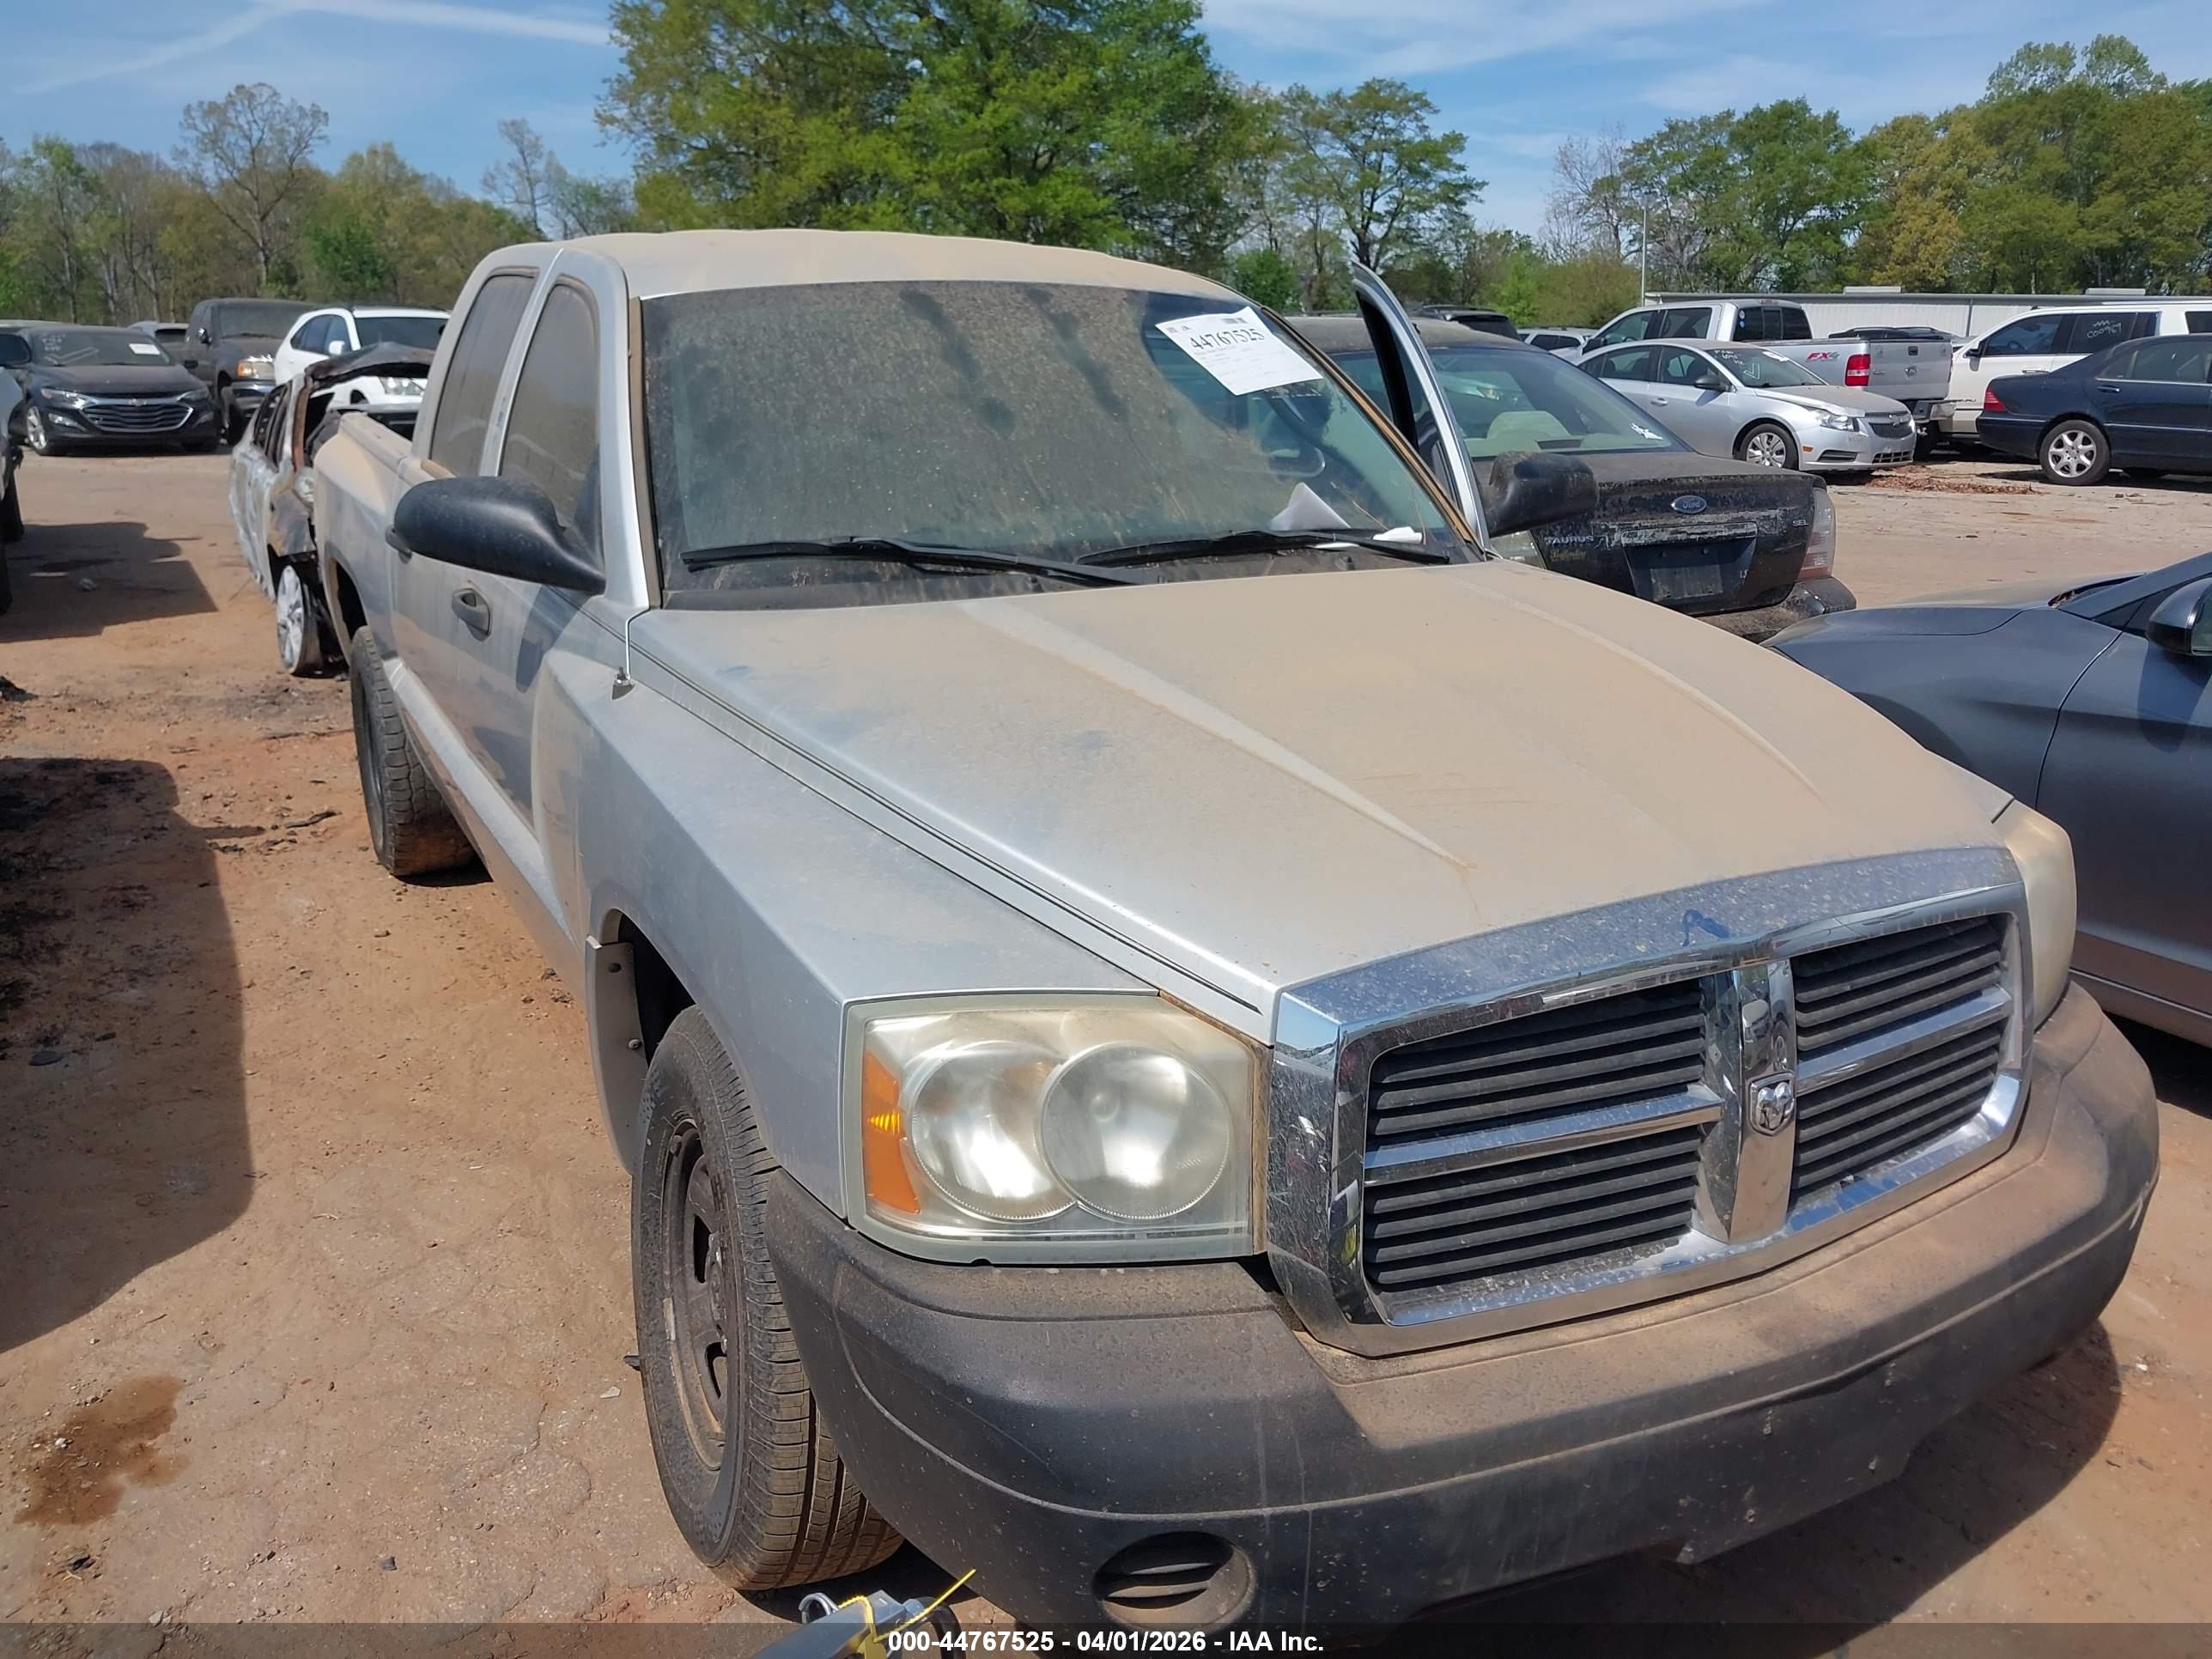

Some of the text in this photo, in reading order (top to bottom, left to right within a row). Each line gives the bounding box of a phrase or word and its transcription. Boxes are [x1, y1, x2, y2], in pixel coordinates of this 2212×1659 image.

[1189, 328, 1265, 349] 44767525
[1807, 351, 1840, 360] FX4
[1543, 535, 1595, 545] TAURUS
